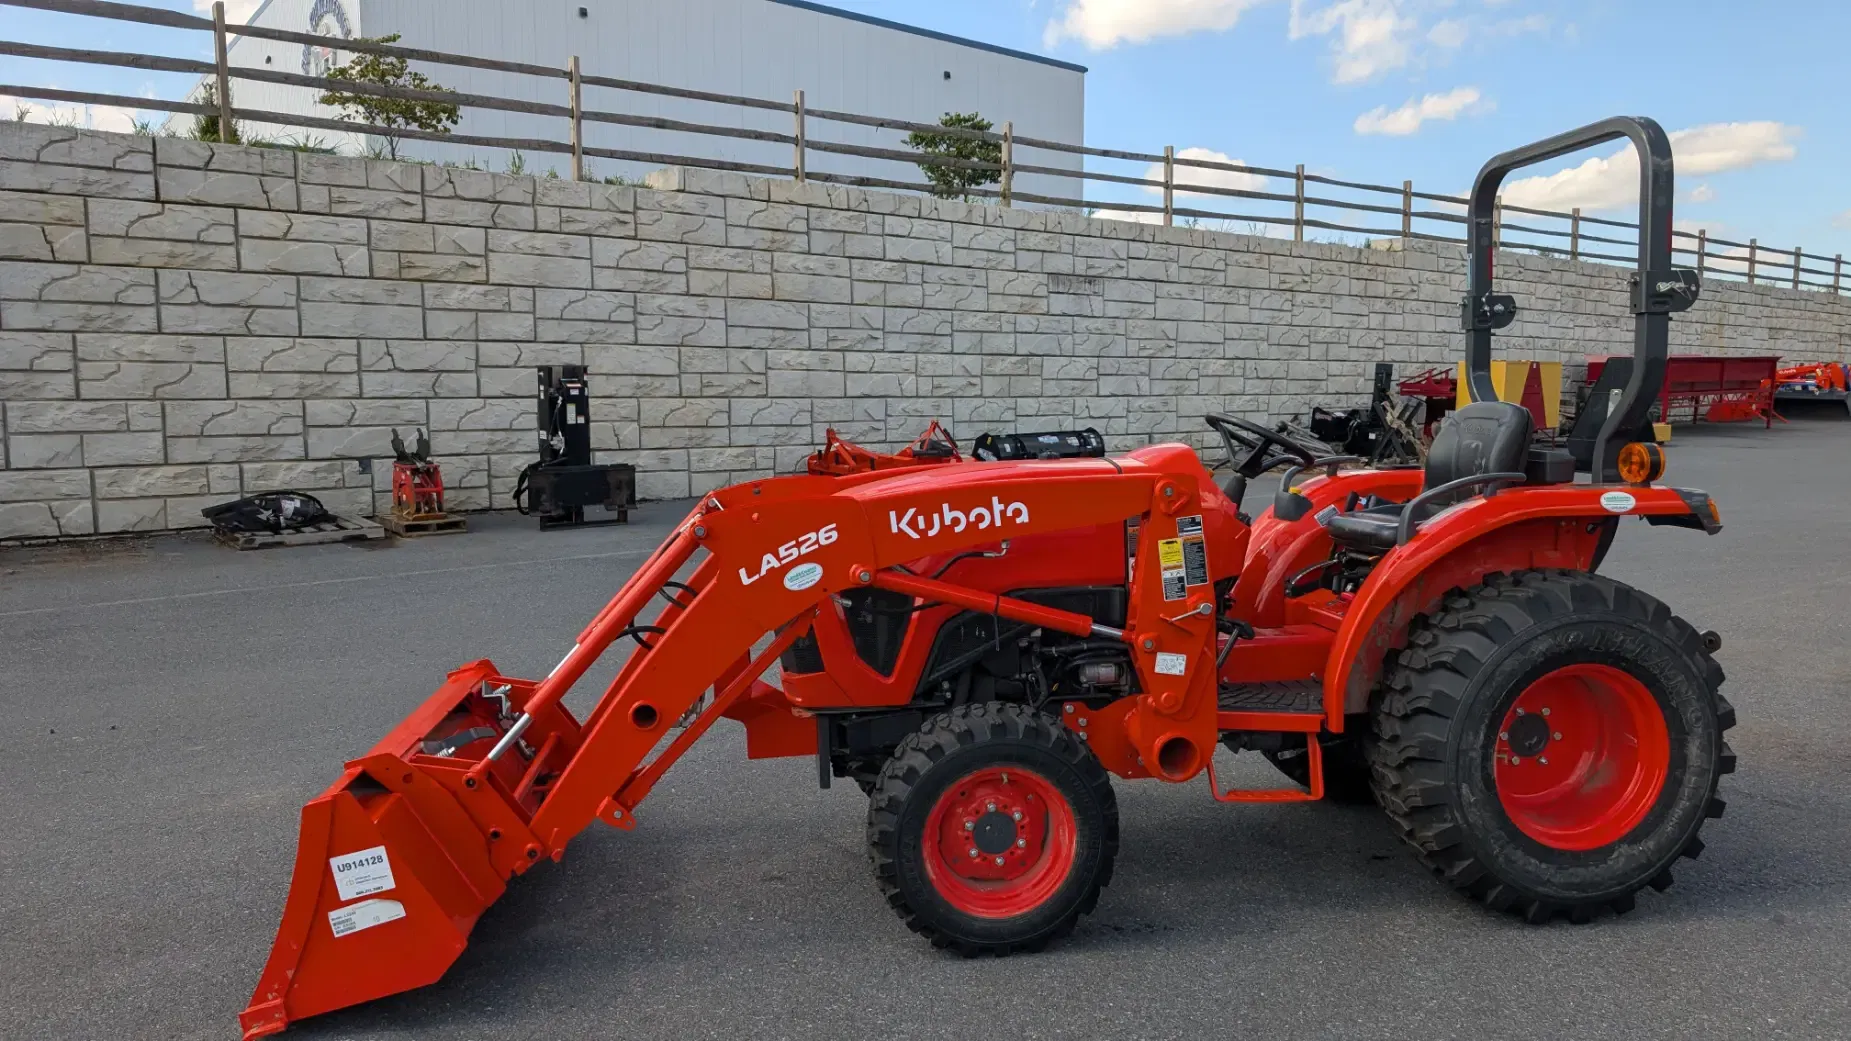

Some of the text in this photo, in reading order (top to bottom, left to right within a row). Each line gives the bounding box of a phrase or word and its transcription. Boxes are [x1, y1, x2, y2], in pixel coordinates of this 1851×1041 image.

[889, 496, 1029, 539] Kubota
[738, 523, 838, 586] LA526
[336, 854, 384, 873] U914128
